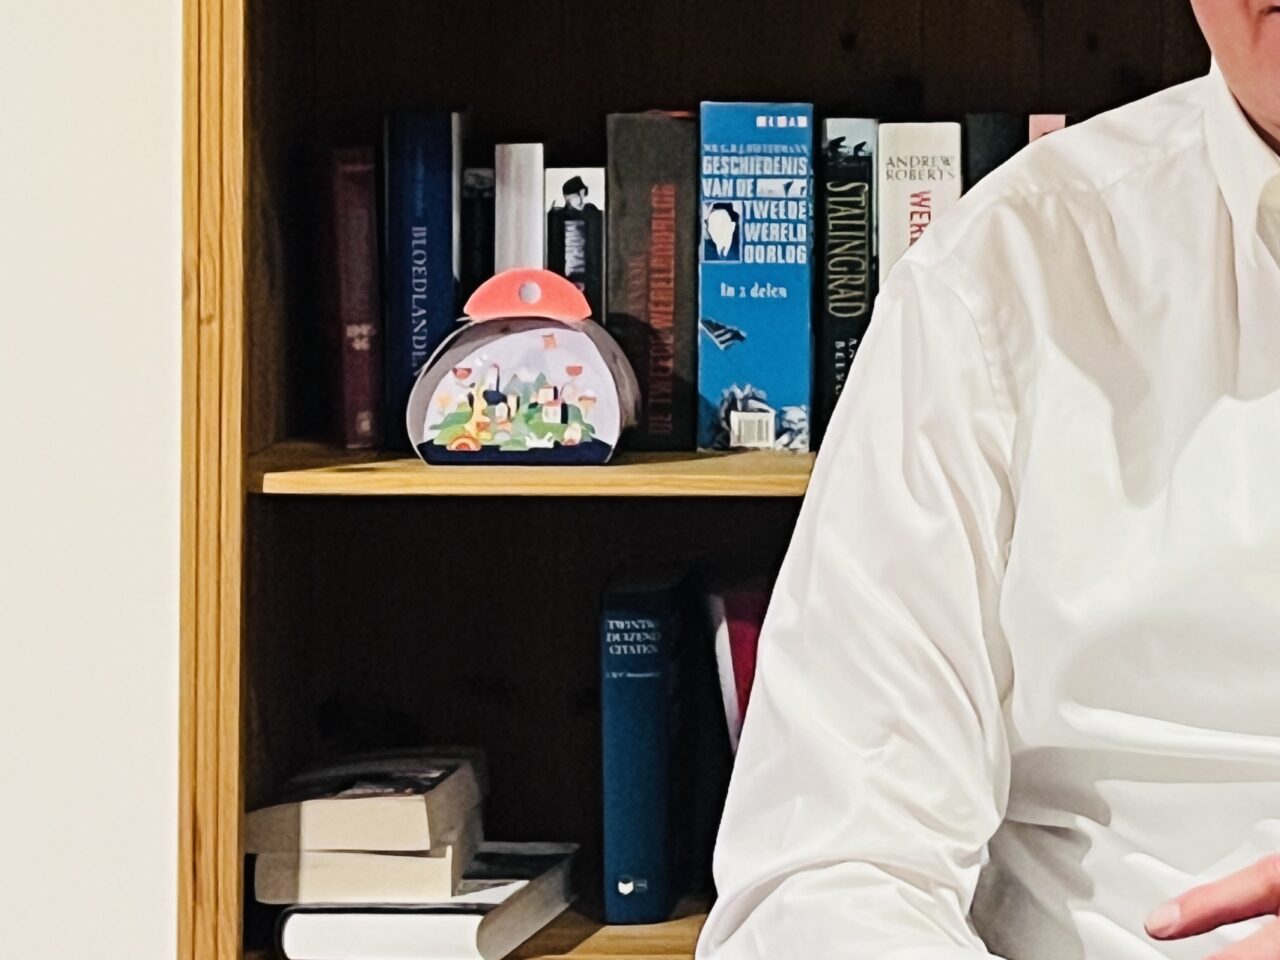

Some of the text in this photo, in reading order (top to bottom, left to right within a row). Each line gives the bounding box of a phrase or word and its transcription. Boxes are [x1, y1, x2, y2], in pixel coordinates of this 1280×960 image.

[703, 155, 808, 175] GESCHIEDENIS
[886, 156, 951, 169] ANDREW
[703, 178, 755, 198] VAN DE
[744, 201, 808, 220] TWEEDE
[909, 190, 932, 247] WER
[744, 222, 807, 242] WERELD
[744, 244, 807, 264] OORLOG
[826, 181, 870, 318] STALINGRAD
[750, 282, 788, 298] delen
